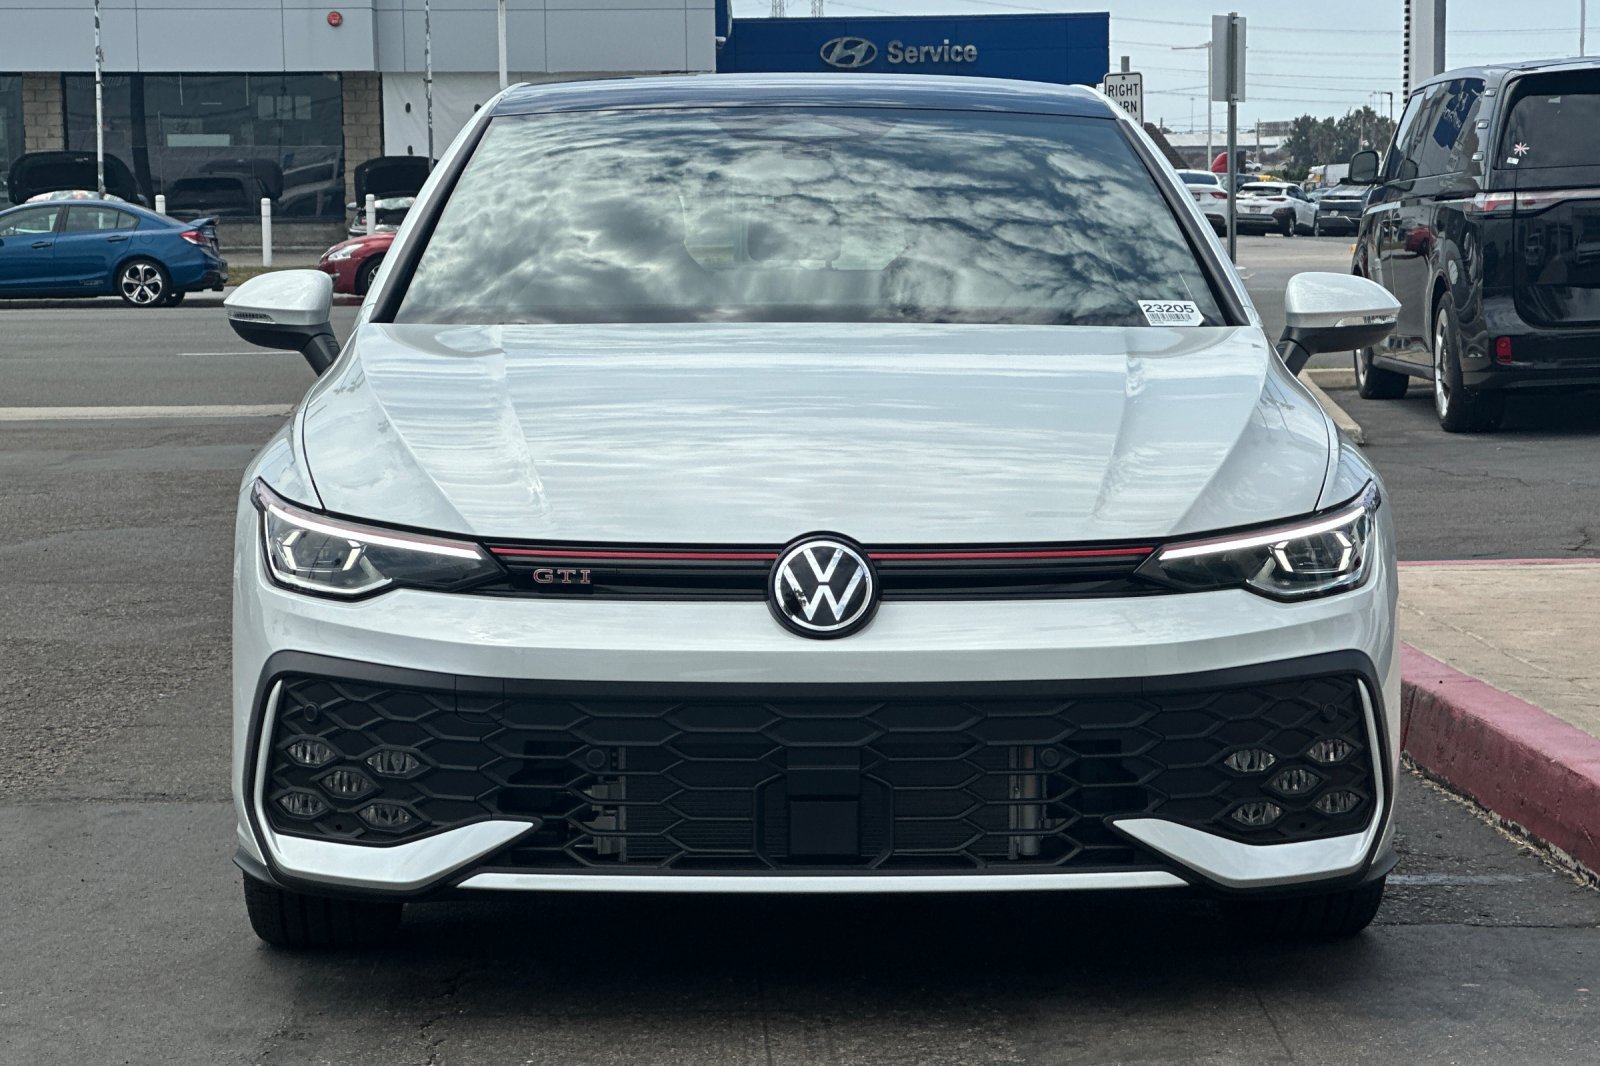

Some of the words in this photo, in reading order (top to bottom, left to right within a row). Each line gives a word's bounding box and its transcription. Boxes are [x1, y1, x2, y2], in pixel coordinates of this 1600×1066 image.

[887, 39, 977, 63] Service
[1108, 83, 1139, 97] RIGHT
[1143, 304, 1195, 313] 23205
[533, 568, 591, 584] GTI
